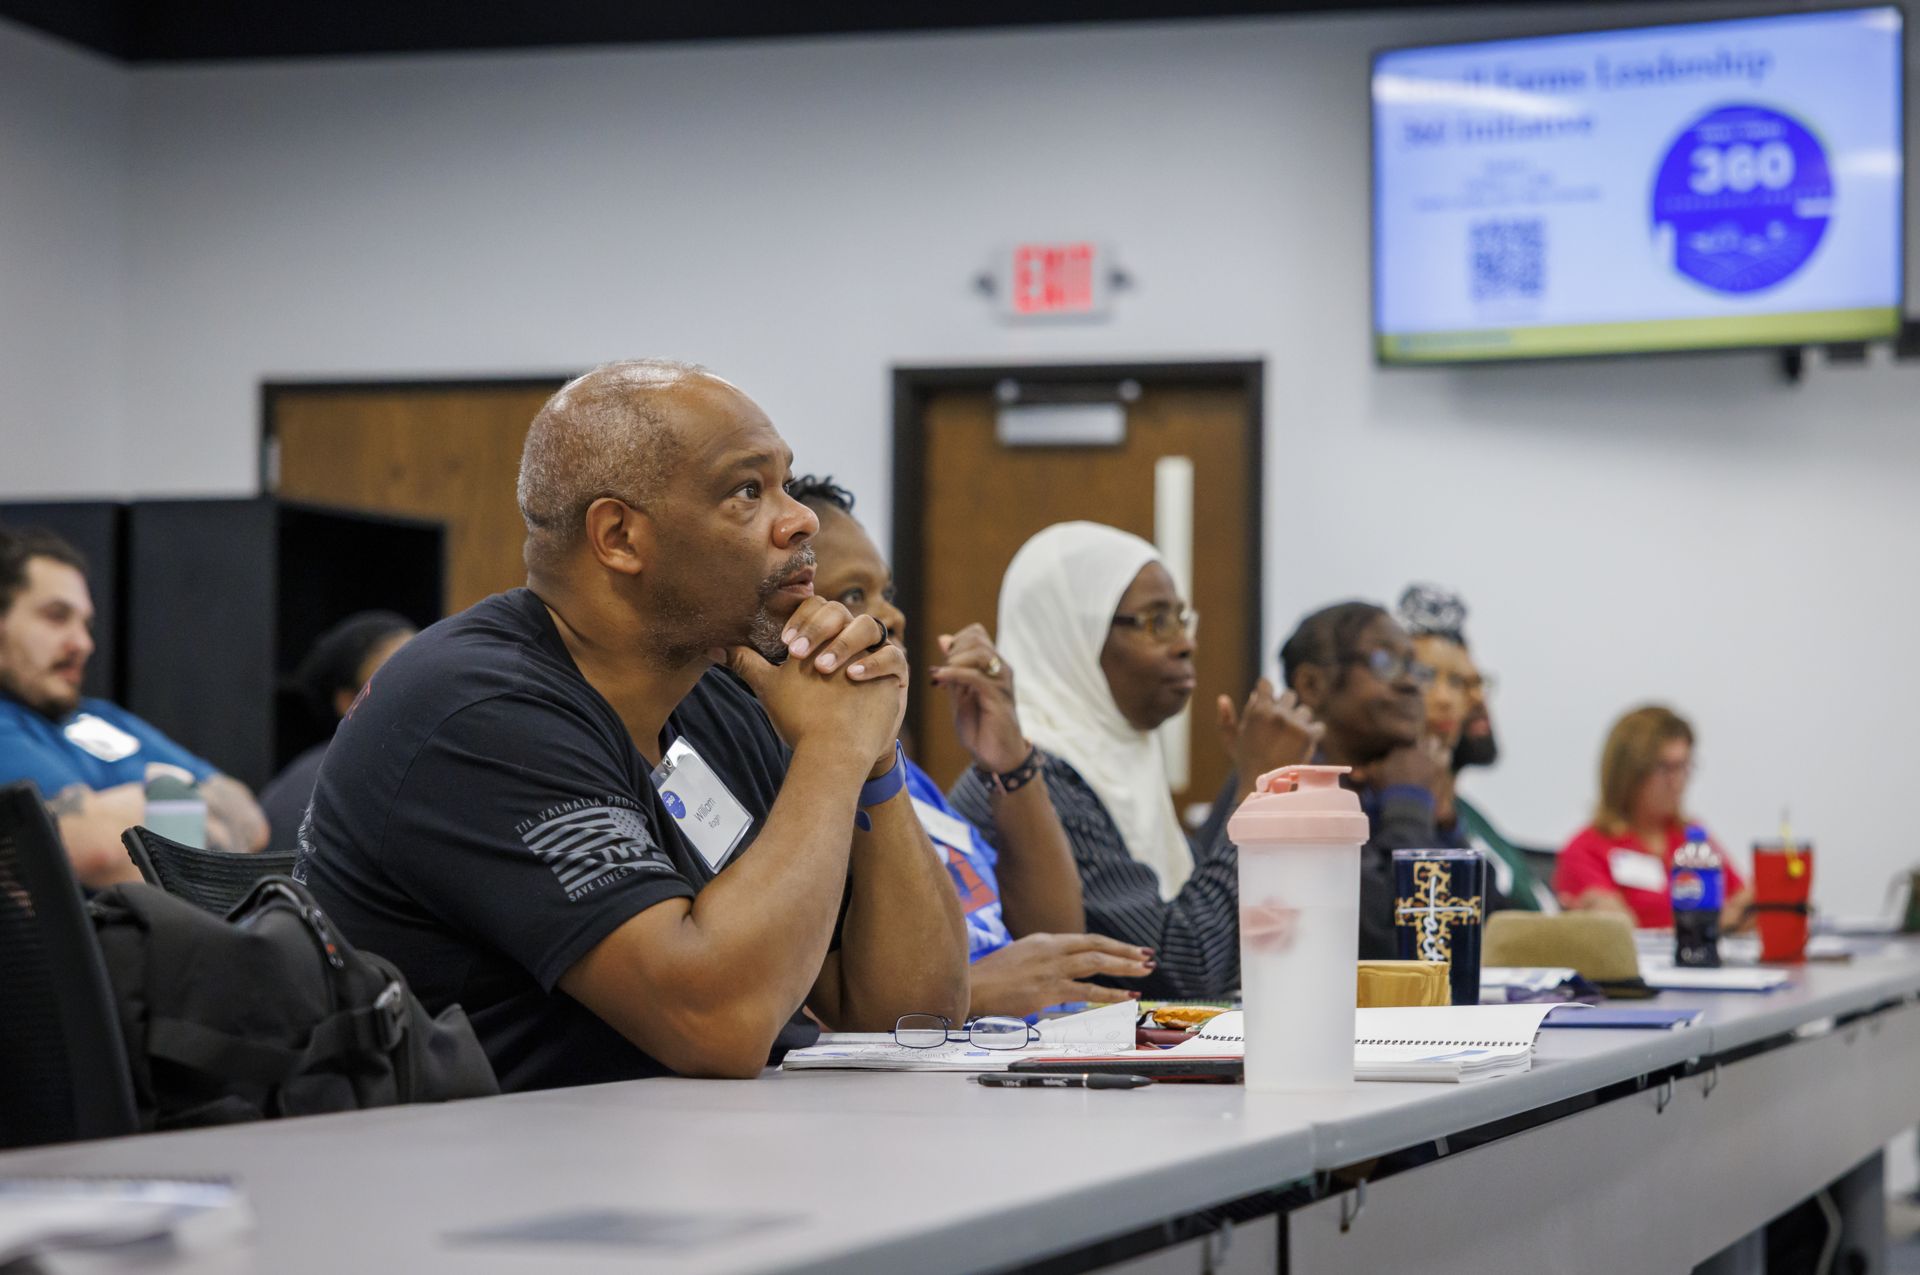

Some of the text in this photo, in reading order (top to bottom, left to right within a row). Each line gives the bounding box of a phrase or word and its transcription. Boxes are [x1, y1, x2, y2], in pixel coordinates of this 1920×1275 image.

[1689, 142, 1796, 195] 360
[514, 818, 536, 835] TIL
[538, 798, 601, 822] VALHALLA
[567, 882, 595, 902] SAVE
[599, 866, 631, 887] LIVES.
